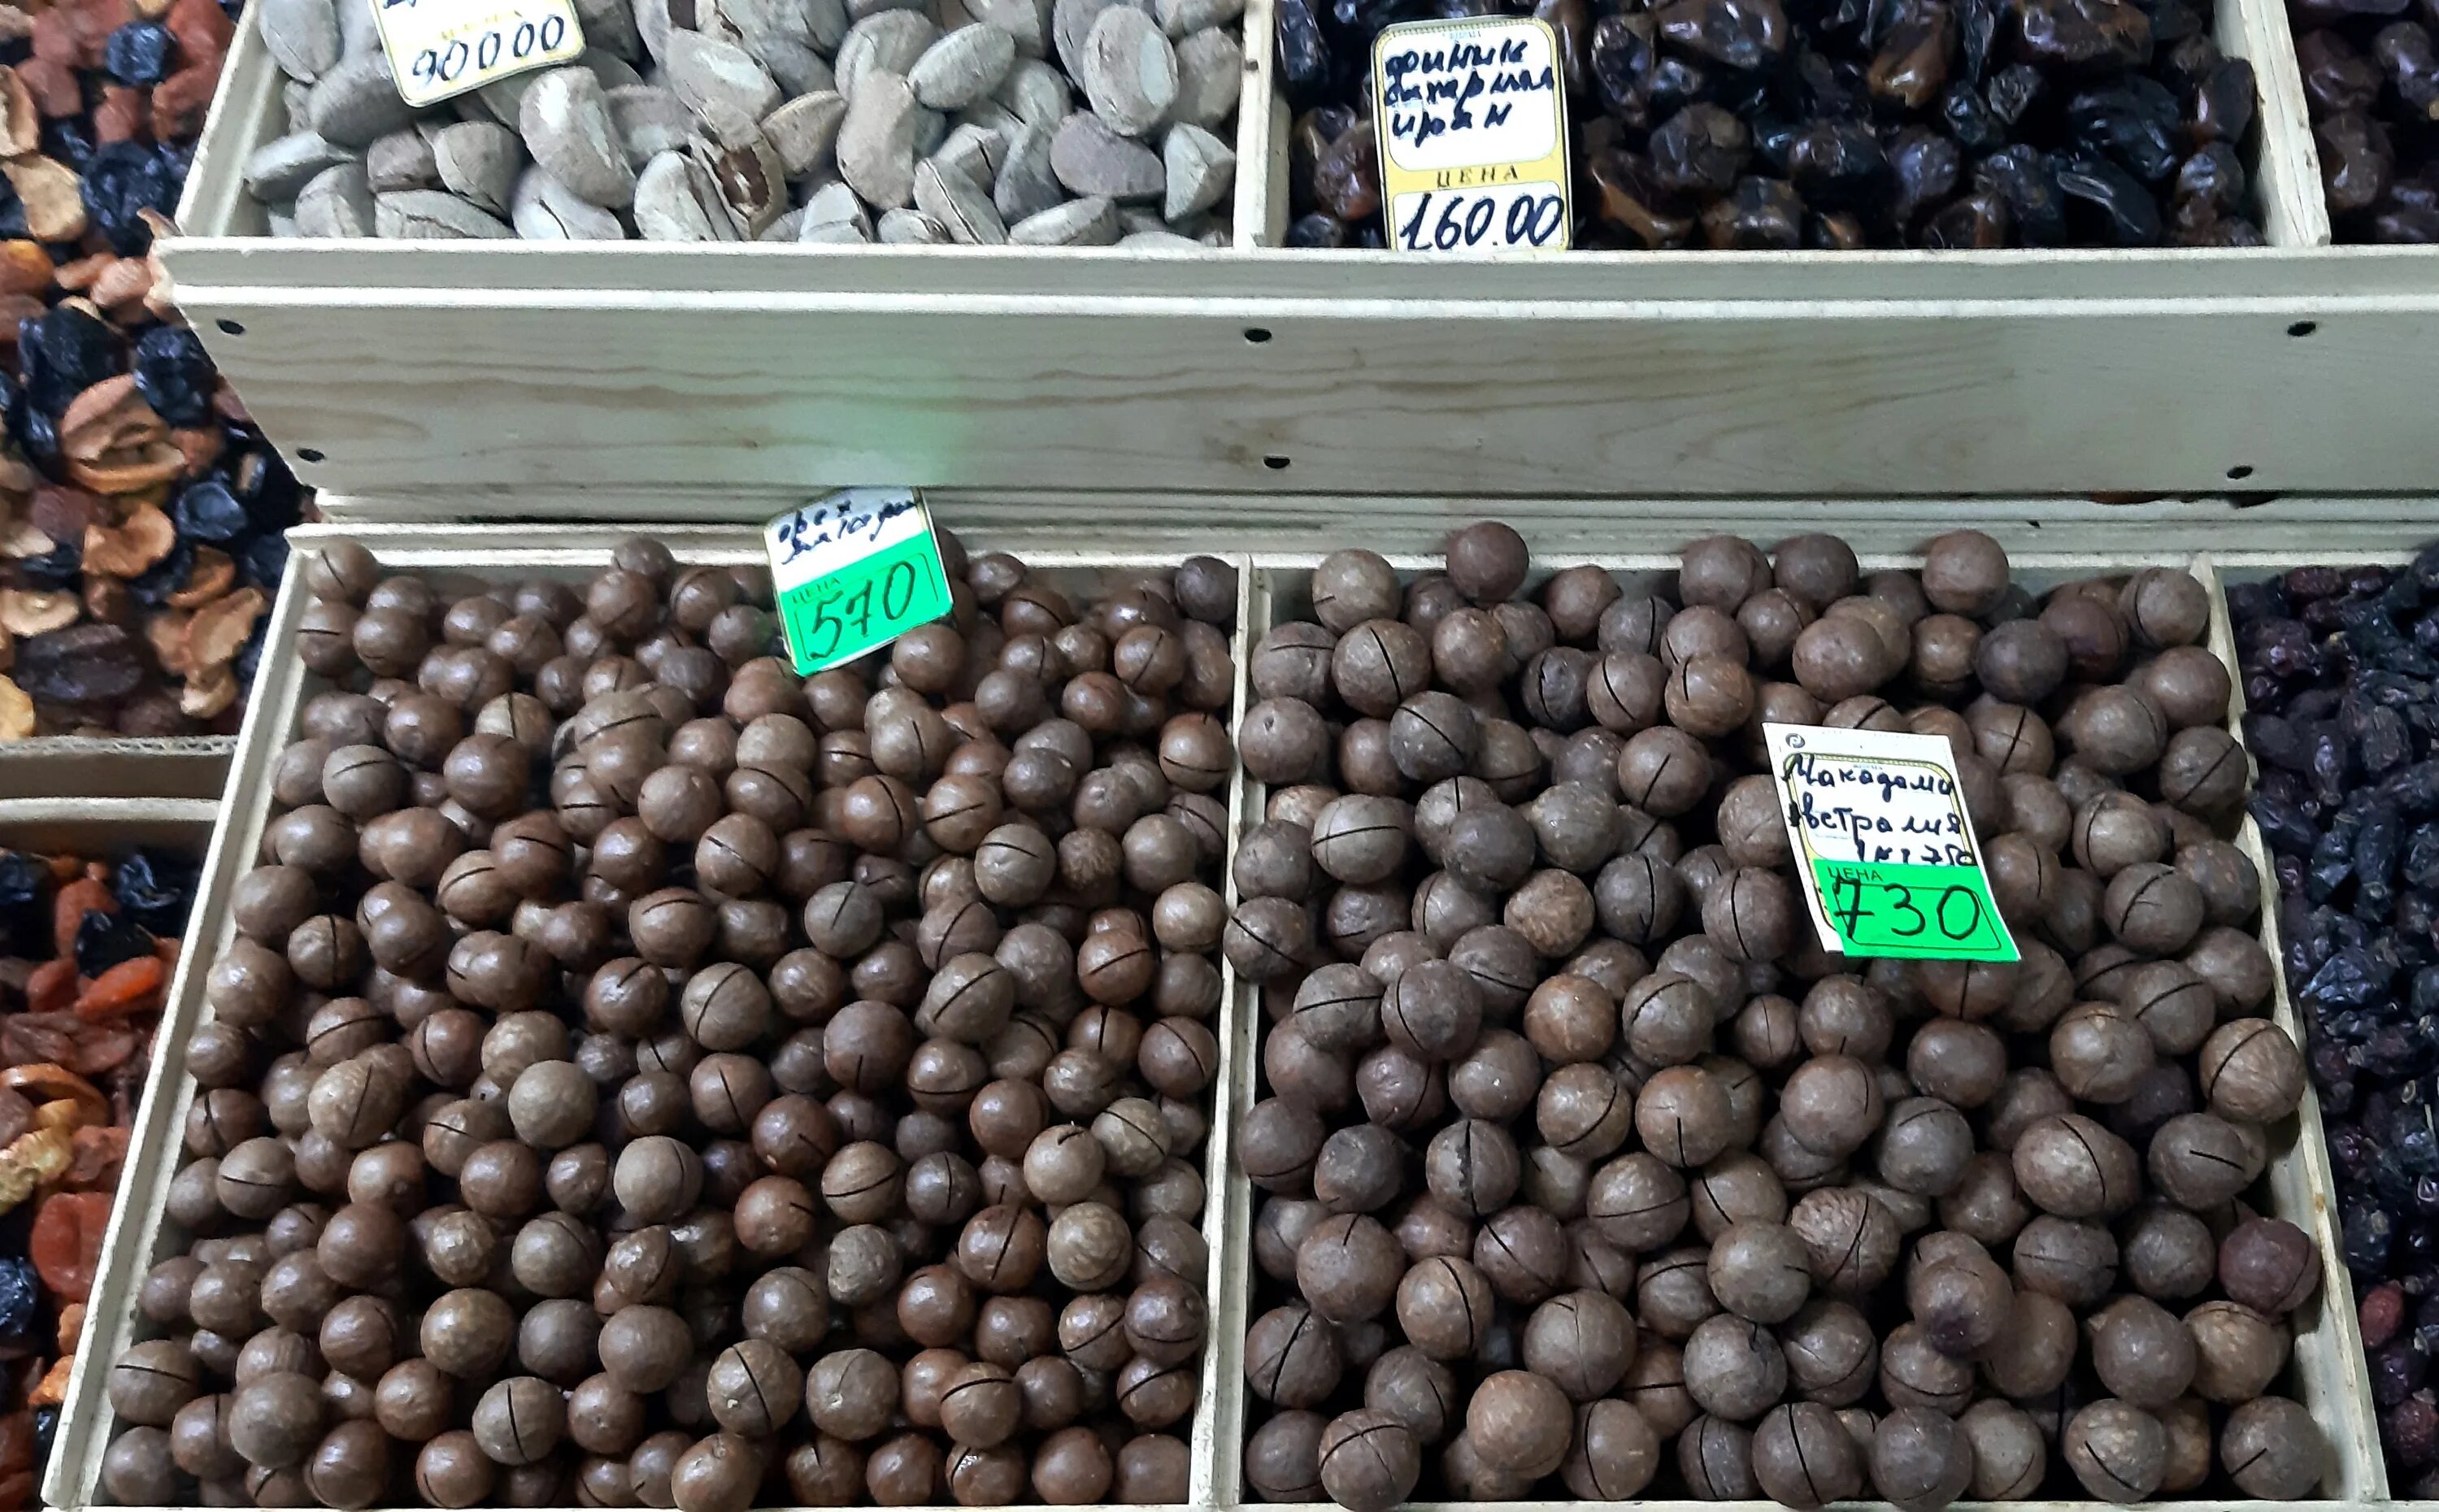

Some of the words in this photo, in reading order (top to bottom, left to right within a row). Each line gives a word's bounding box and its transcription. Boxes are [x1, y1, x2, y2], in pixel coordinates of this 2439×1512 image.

[1436, 165, 1519, 189] ЦЕНА
[1399, 192, 1565, 250] 160.00
[809, 561, 916, 659] 570
[1828, 866, 1884, 885] ЦЕНА
[1833, 875, 1980, 941] 730
